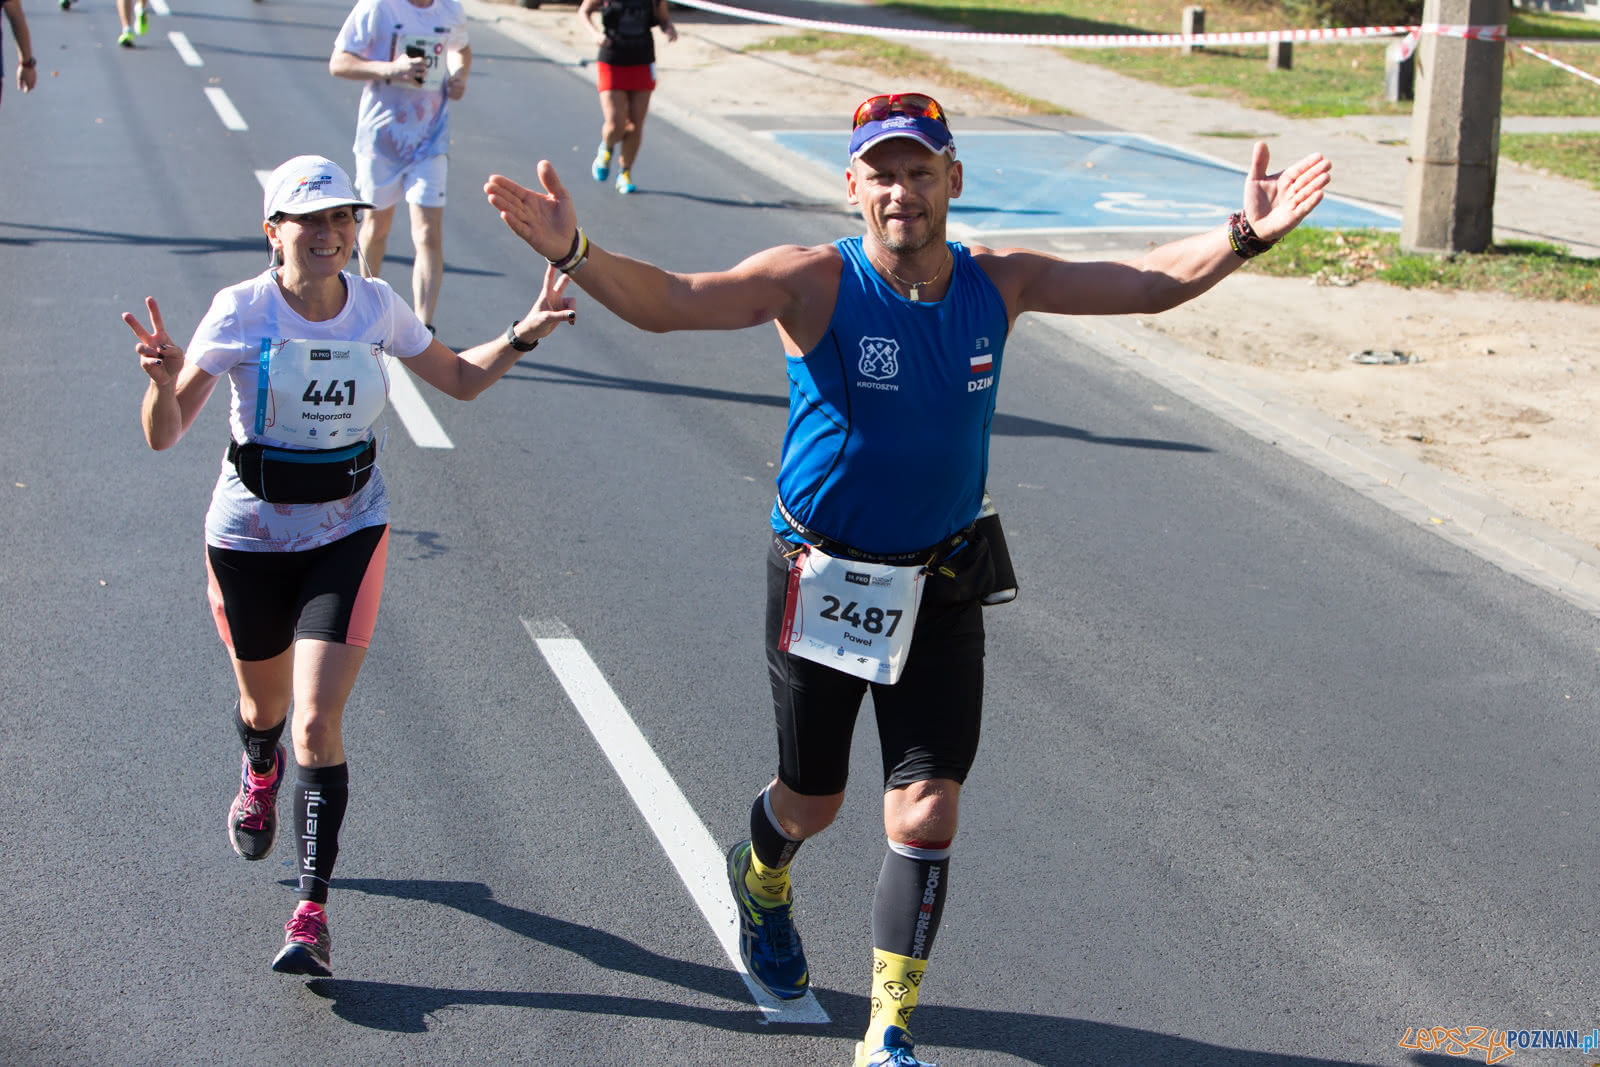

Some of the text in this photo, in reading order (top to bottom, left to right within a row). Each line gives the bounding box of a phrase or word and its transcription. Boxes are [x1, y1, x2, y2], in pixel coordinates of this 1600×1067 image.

[302, 380, 356, 406] 441
[857, 381, 899, 392] KROTOSZYN
[302, 412, 351, 422] Małgorzata
[820, 595, 903, 638] 2487
[843, 632, 873, 647] Paweł
[911, 866, 941, 961] OMPRESSPORT
